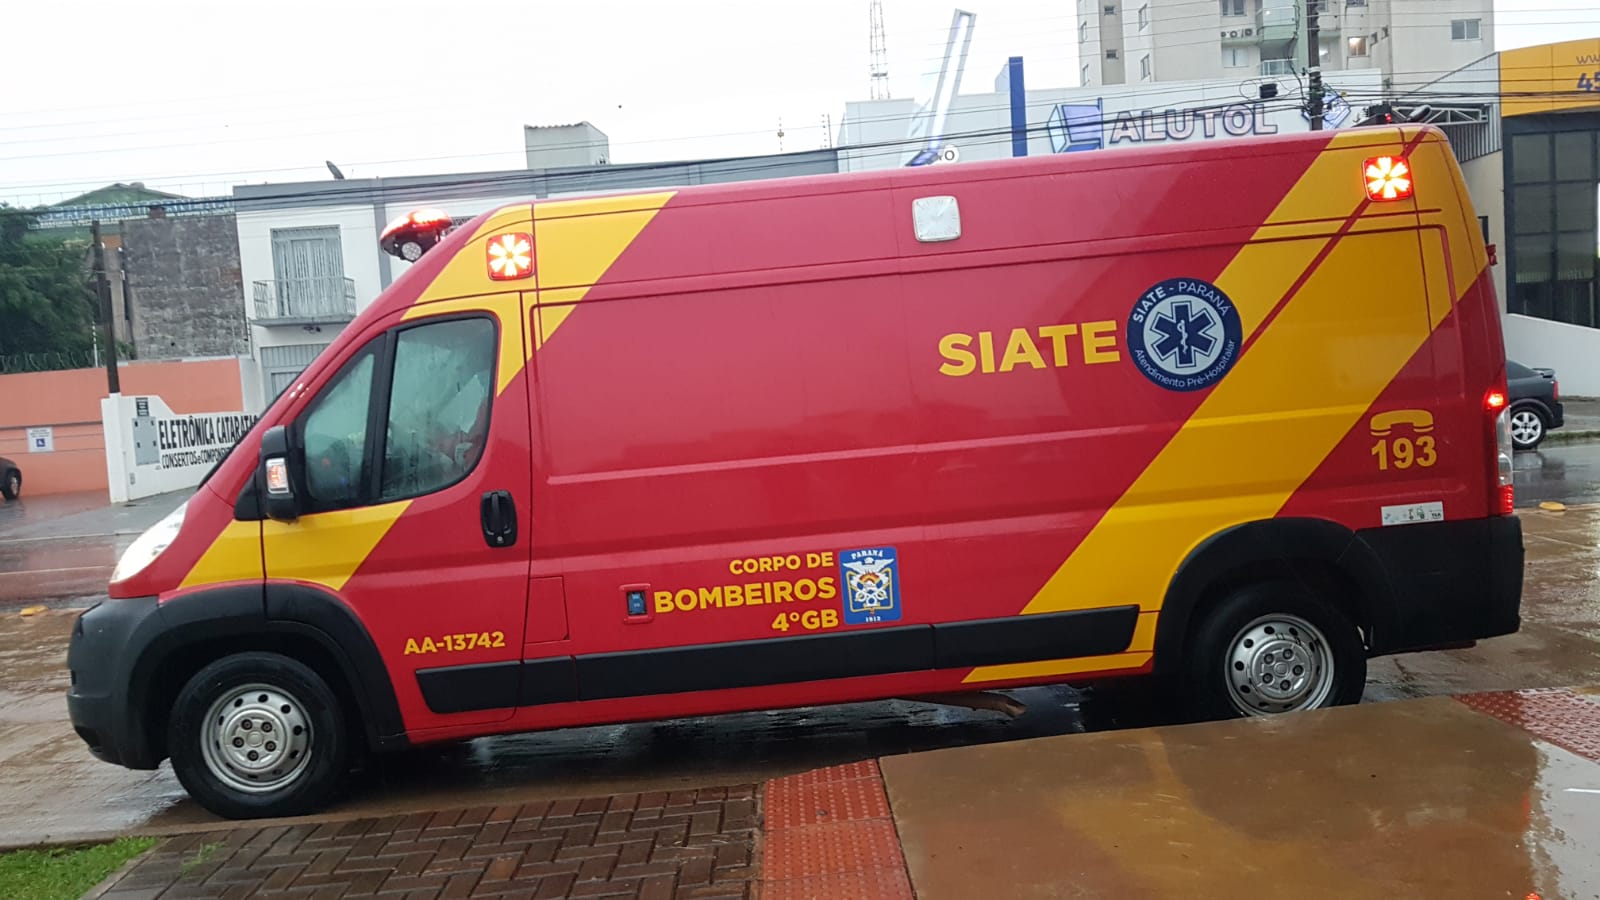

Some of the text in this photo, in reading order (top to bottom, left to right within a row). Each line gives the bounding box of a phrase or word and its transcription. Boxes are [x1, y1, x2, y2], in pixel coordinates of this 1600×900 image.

[1109, 103, 1278, 144] ALUTOL
[1133, 286, 1166, 323] SIATE
[1178, 281, 1231, 316] PARANÁ
[939, 320, 1121, 376] SIATE
[1135, 349, 1185, 387] Atendimento
[158, 414, 259, 450] ELETRÔNICA CATARAT
[1371, 435, 1437, 470] 193
[729, 551, 834, 575] CORPO DE
[653, 576, 836, 613] BOMBEIROS
[404, 631, 506, 655] AA-13742
